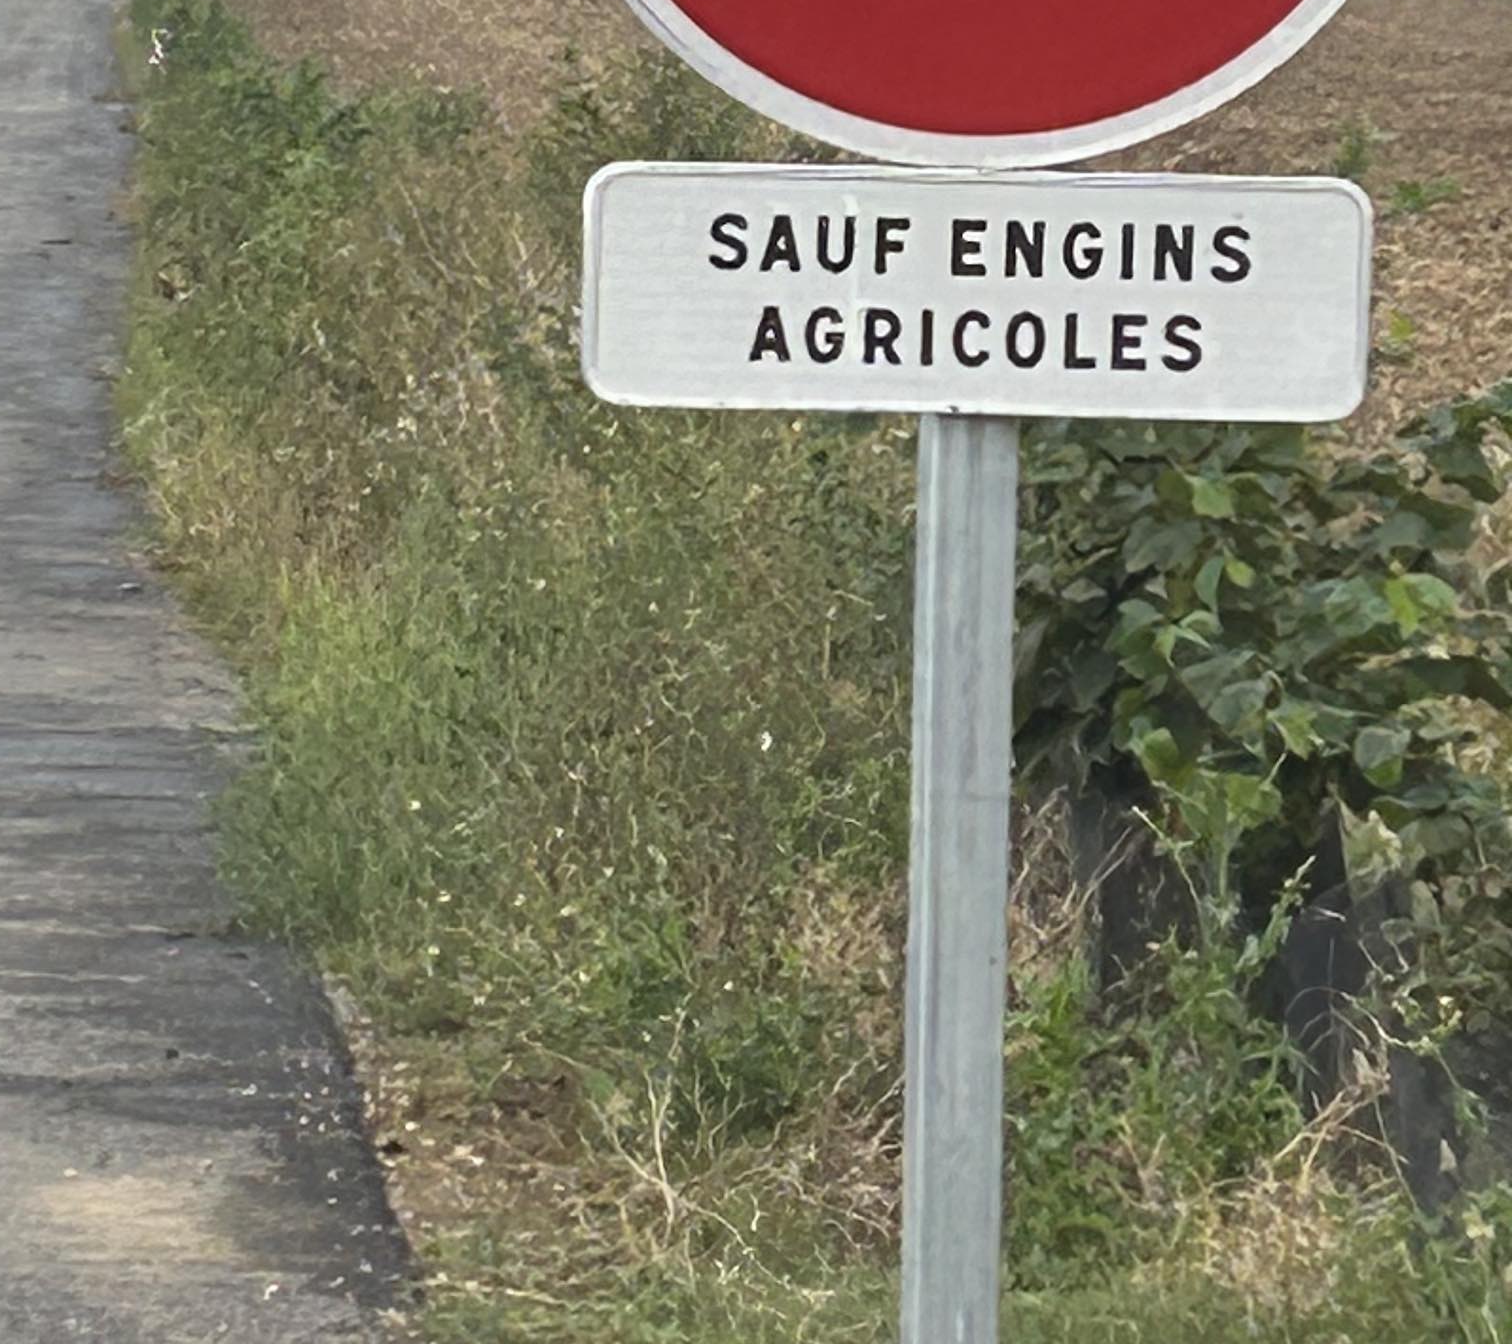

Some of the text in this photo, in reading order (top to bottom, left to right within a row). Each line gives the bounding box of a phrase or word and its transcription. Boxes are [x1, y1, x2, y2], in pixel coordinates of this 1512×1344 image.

[708, 213, 1251, 283] SAUF ENGINS
[749, 305, 1202, 372] AGRICOLES
